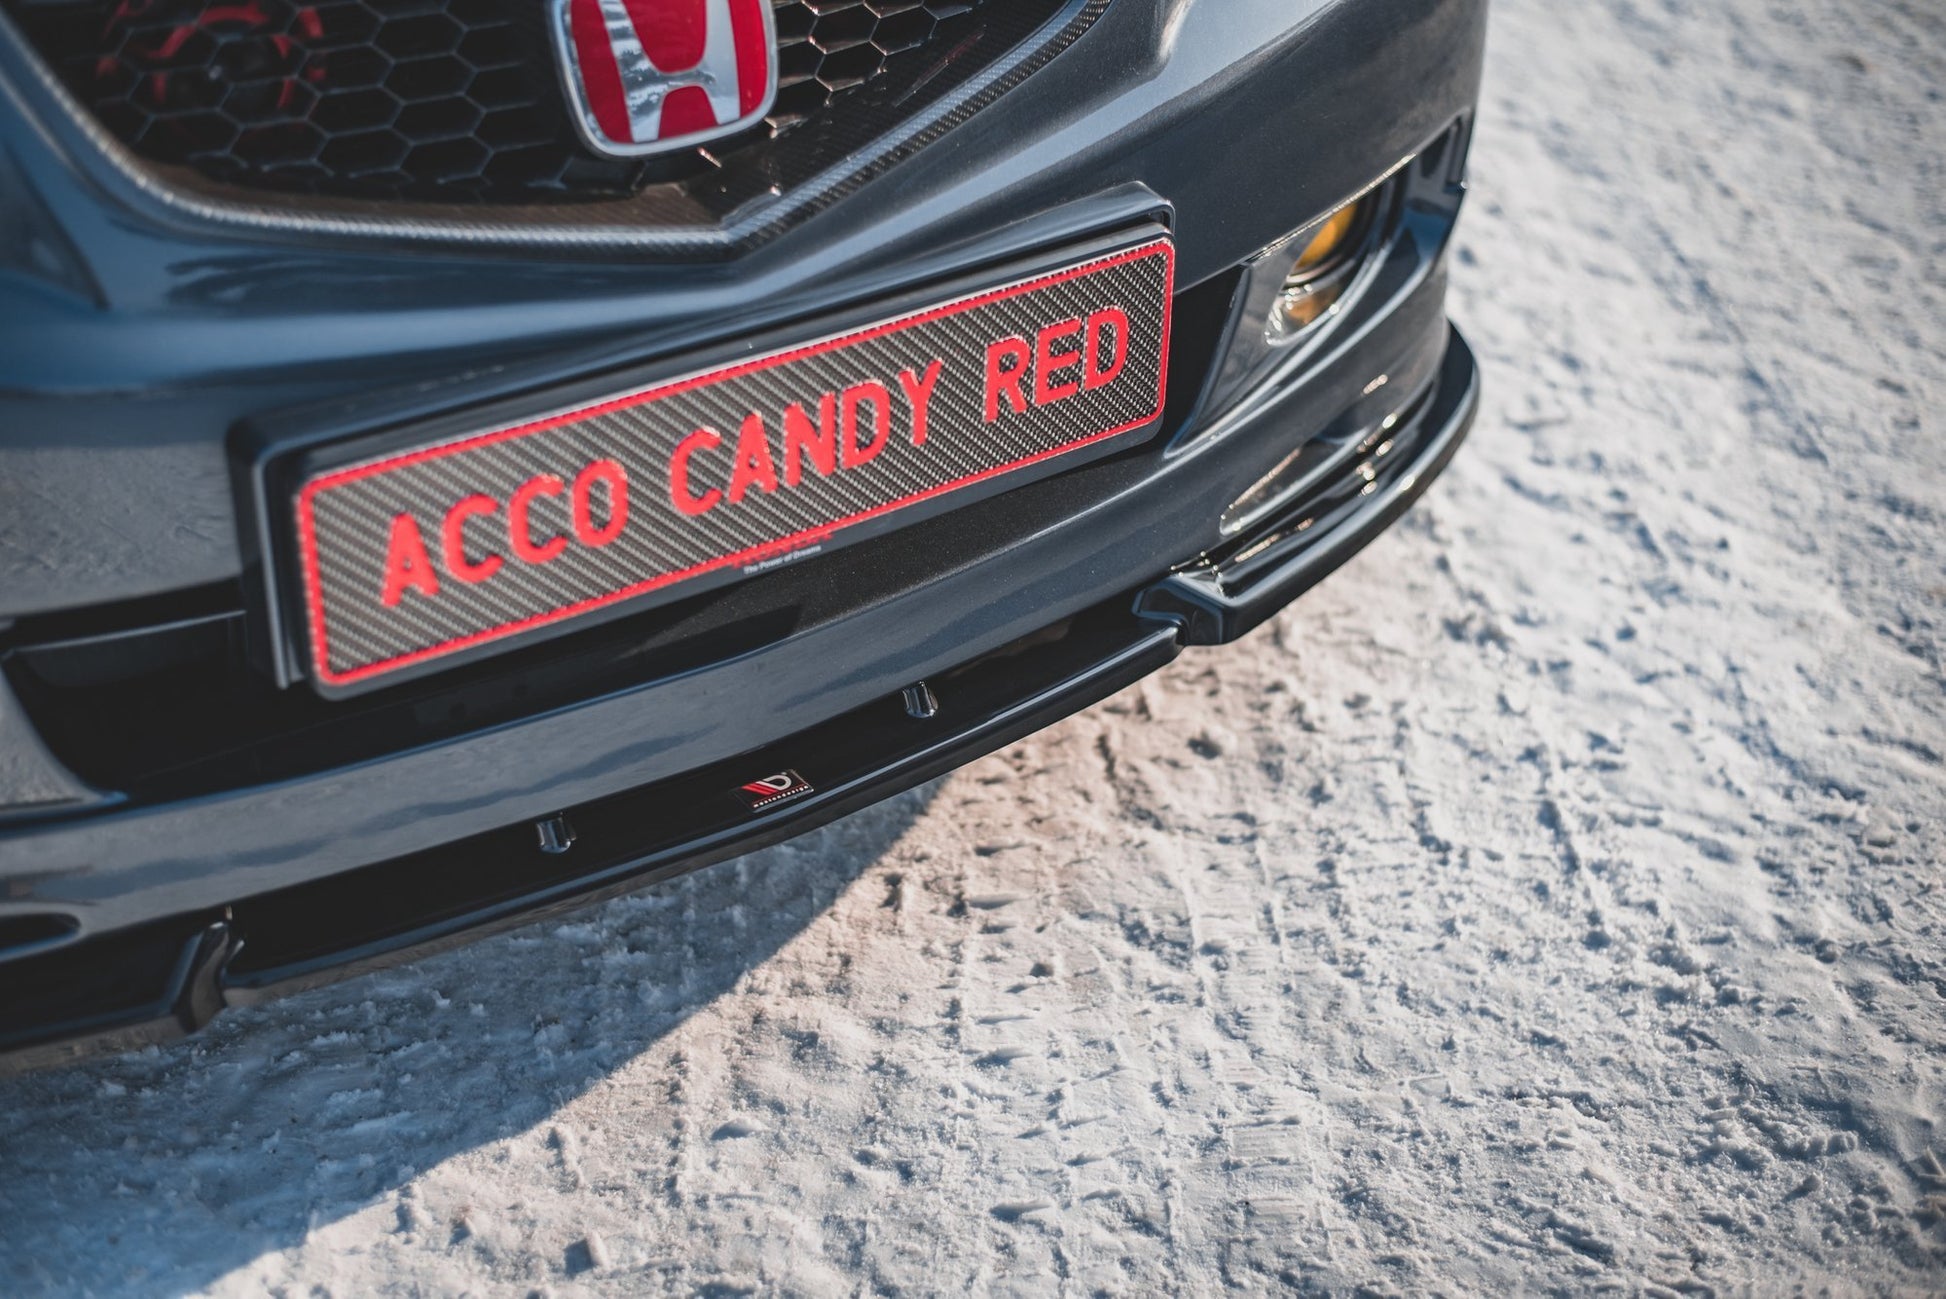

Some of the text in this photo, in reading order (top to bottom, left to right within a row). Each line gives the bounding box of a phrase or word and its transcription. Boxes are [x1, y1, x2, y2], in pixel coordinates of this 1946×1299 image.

[379, 307, 1131, 609] ACCO CANDY RED
